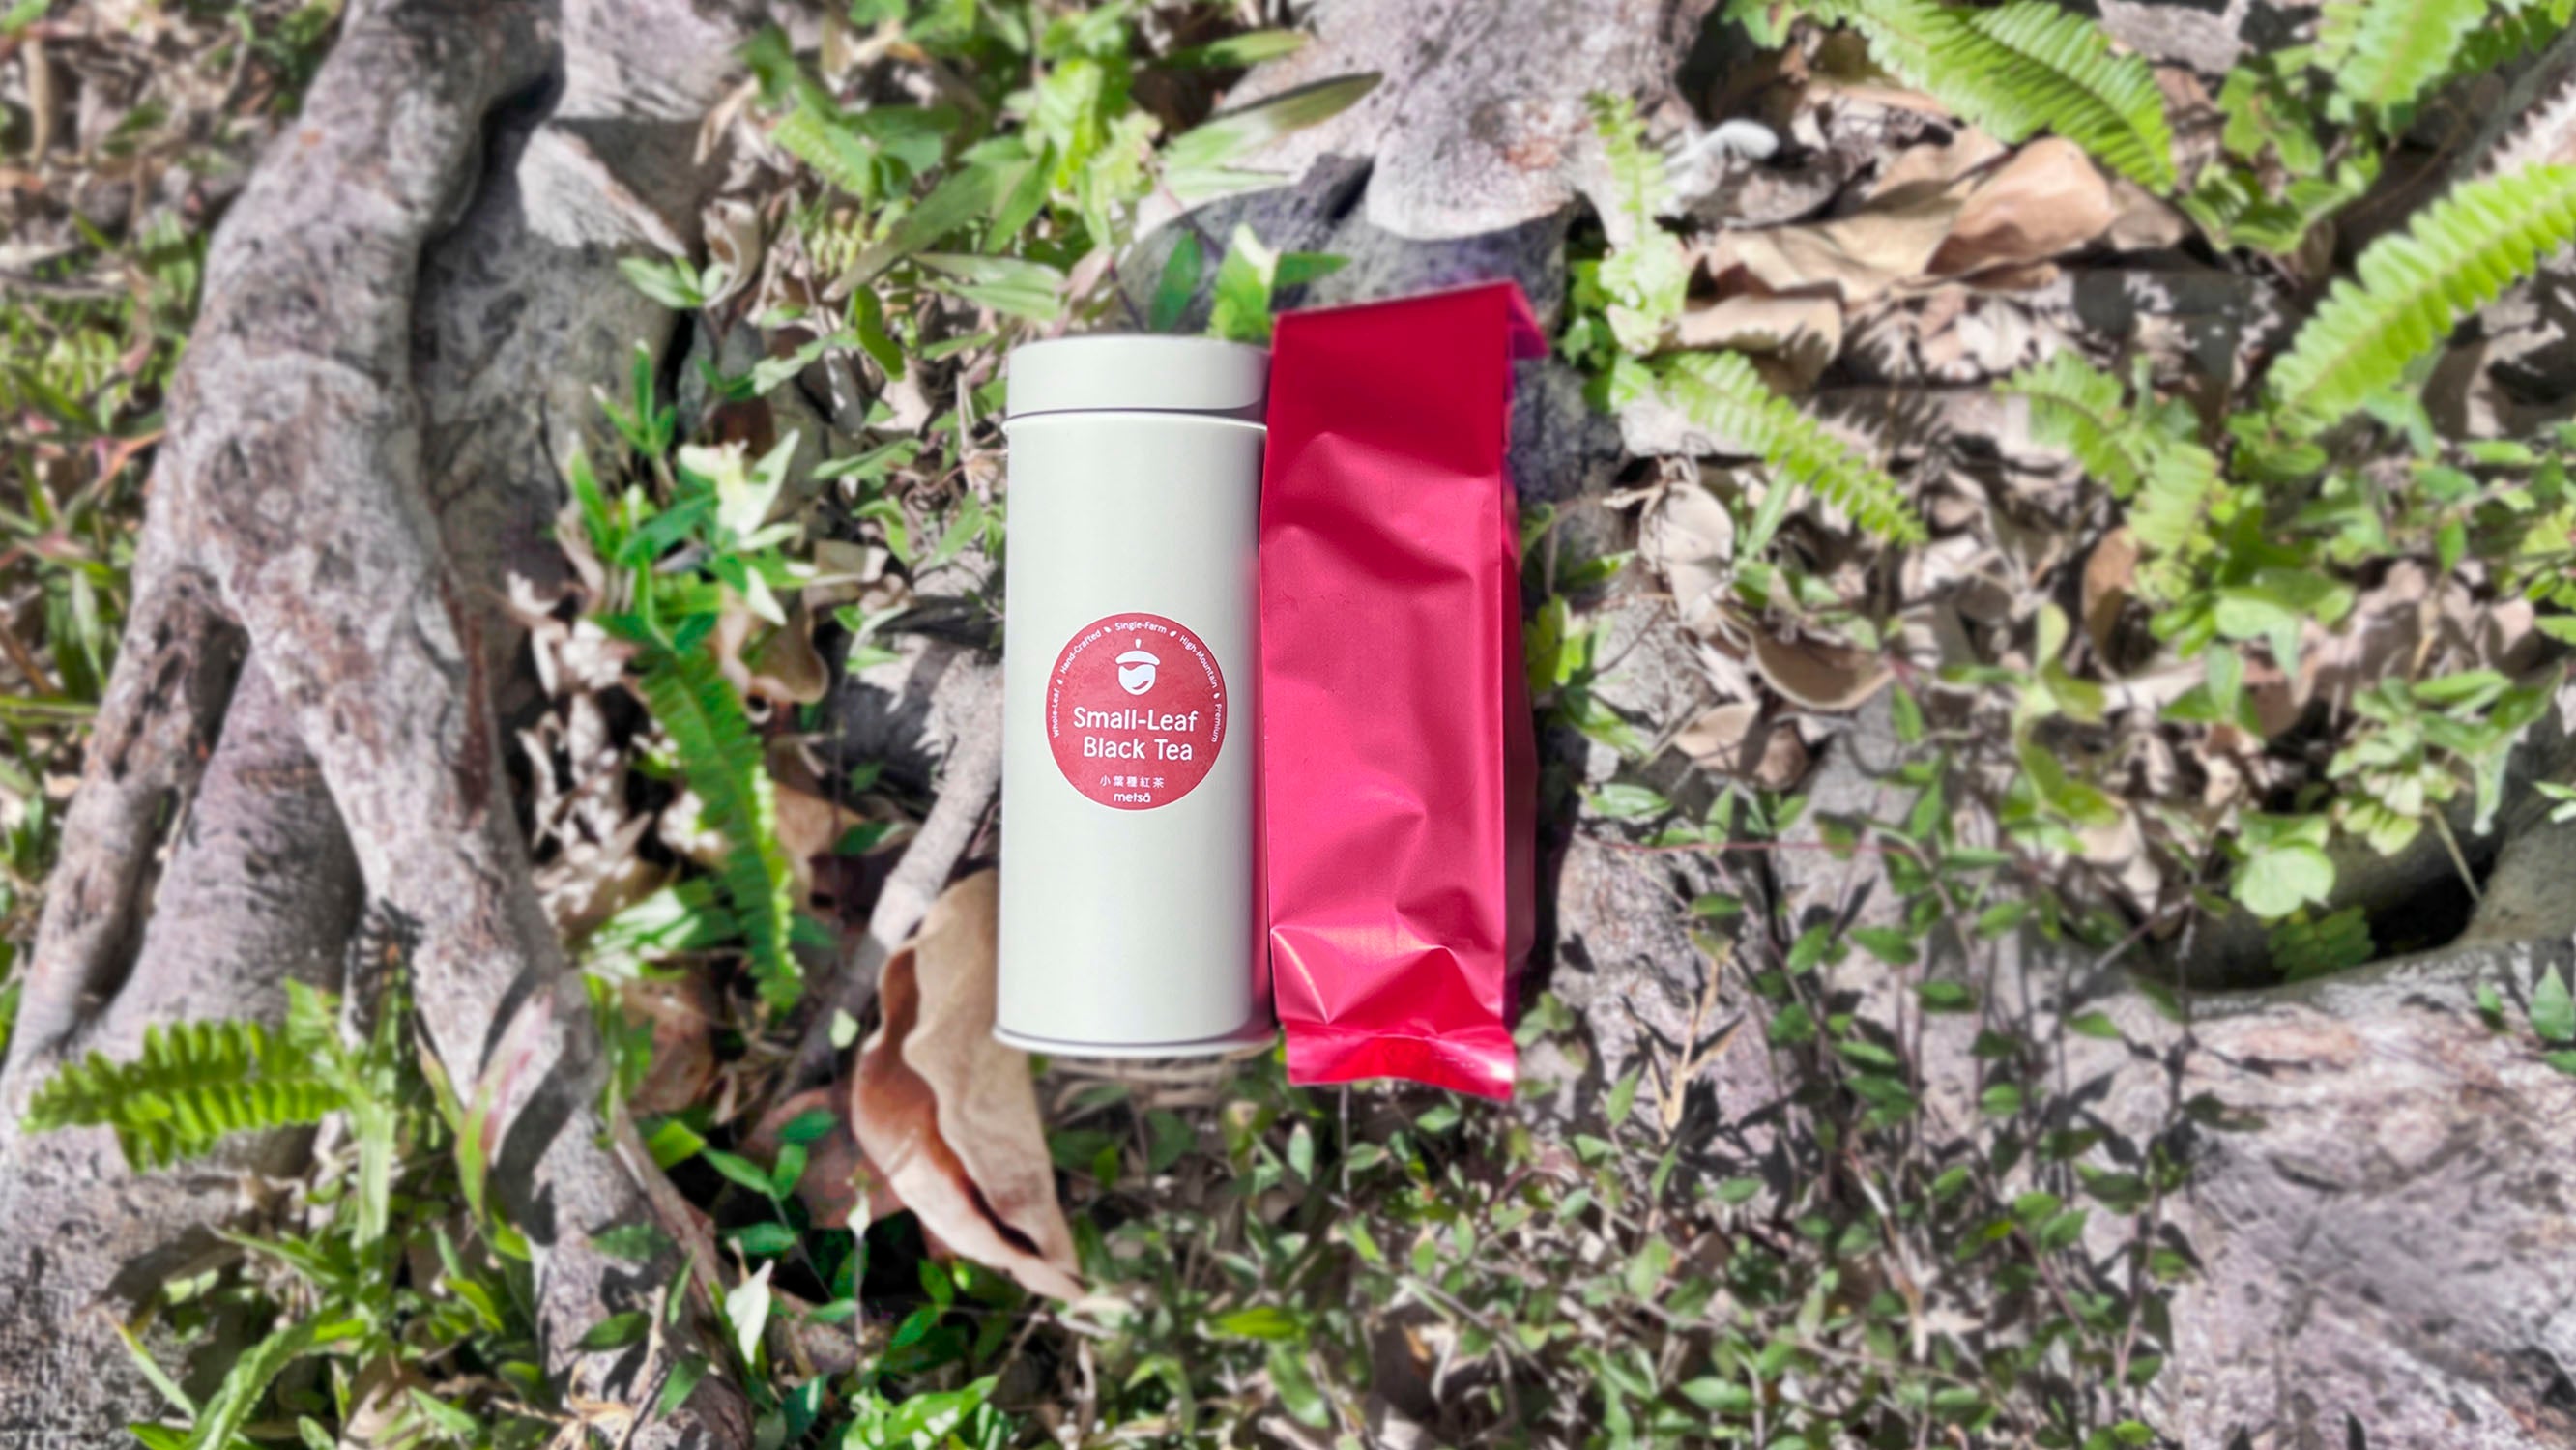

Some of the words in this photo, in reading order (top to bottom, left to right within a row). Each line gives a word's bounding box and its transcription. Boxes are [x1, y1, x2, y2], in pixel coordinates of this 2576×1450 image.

[1060, 630, 1102, 674] Hand-Crafted
[1114, 622, 1167, 634] Single-Farm
[1179, 635, 1218, 688] High-Mountain
[1211, 704, 1223, 743] Premium
[1073, 707, 1199, 732] Small-Leaf
[1083, 736, 1145, 759] Black
[1154, 739, 1193, 761] Tea
[1099, 775, 1165, 788] 小葉種紅茶
